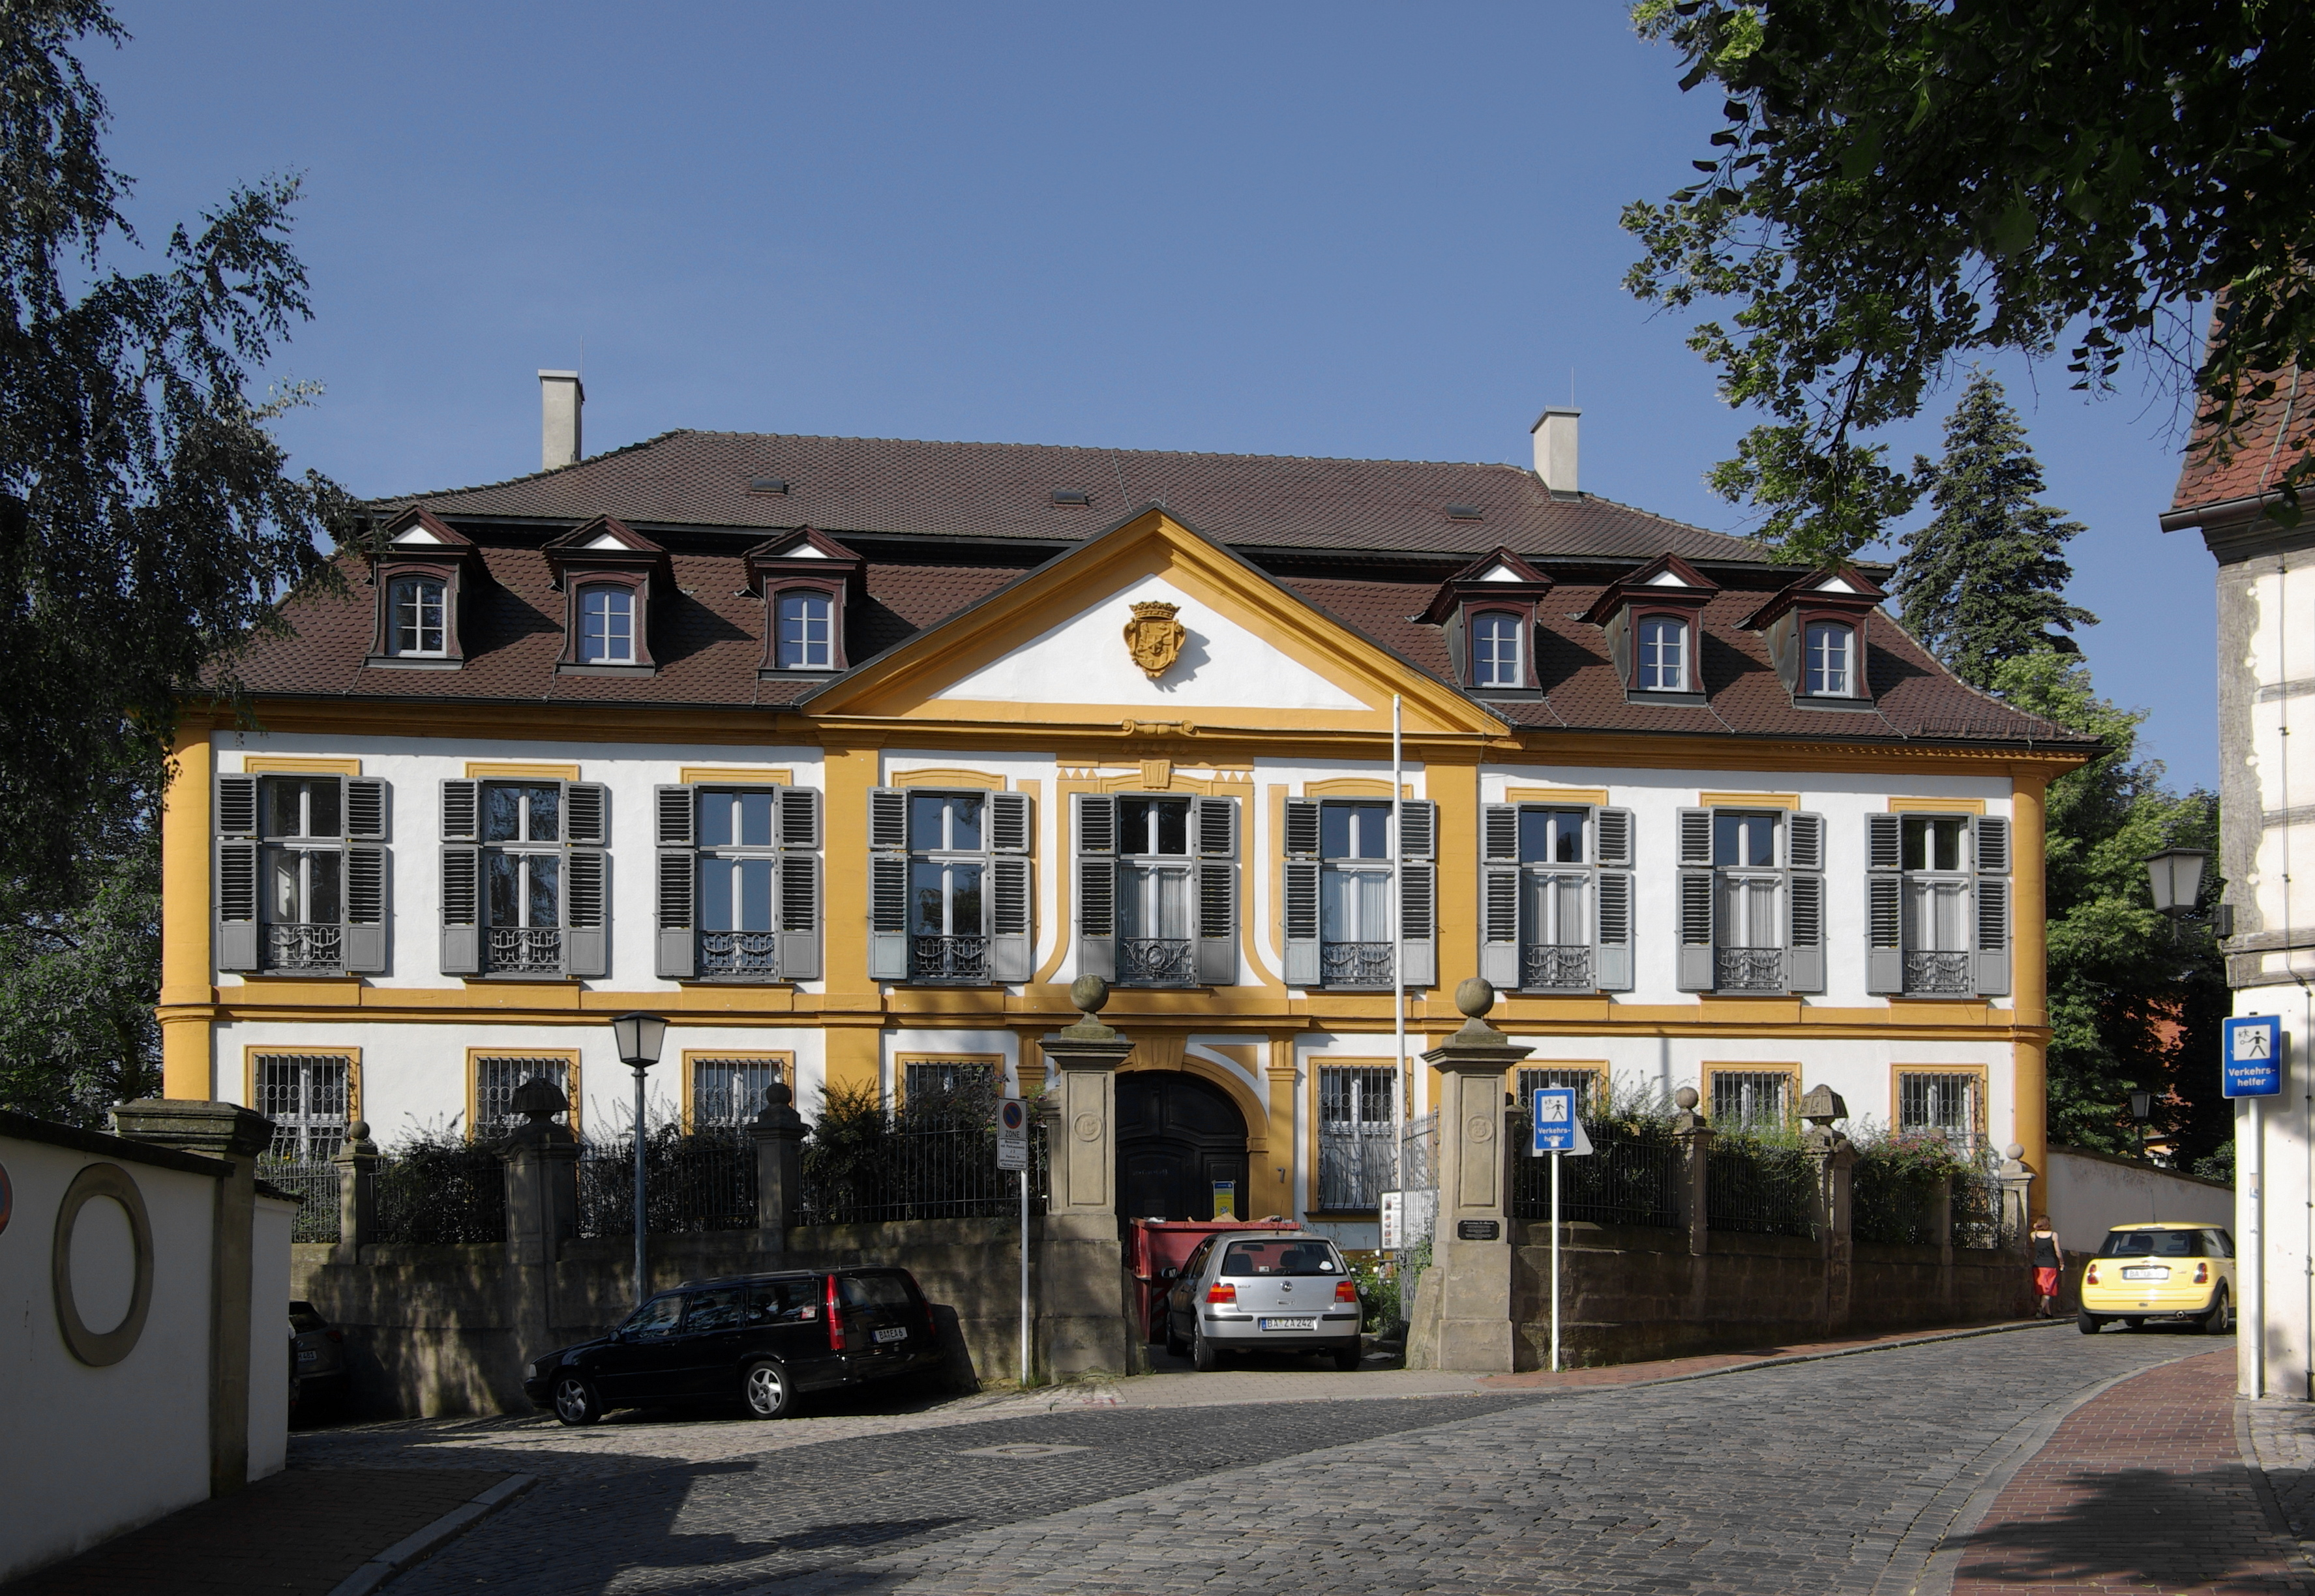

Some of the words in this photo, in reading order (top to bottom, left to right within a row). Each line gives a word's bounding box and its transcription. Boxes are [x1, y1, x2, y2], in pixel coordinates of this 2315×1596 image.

[2228, 1067, 2276, 1076] Verkehrs-
[2237, 1077, 2266, 1087] helfer
[1005, 1130, 1020, 1138] ZONE
[1276, 1167, 1286, 1183] 7
[1267, 1319, 1279, 1327] BA
[1284, 1318, 1295, 1327] ZA
[1296, 1318, 1312, 1327] 242
[878, 1330, 888, 1339] BA
[889, 1329, 899, 1338] EA
[899, 1328, 903, 1337] 6
